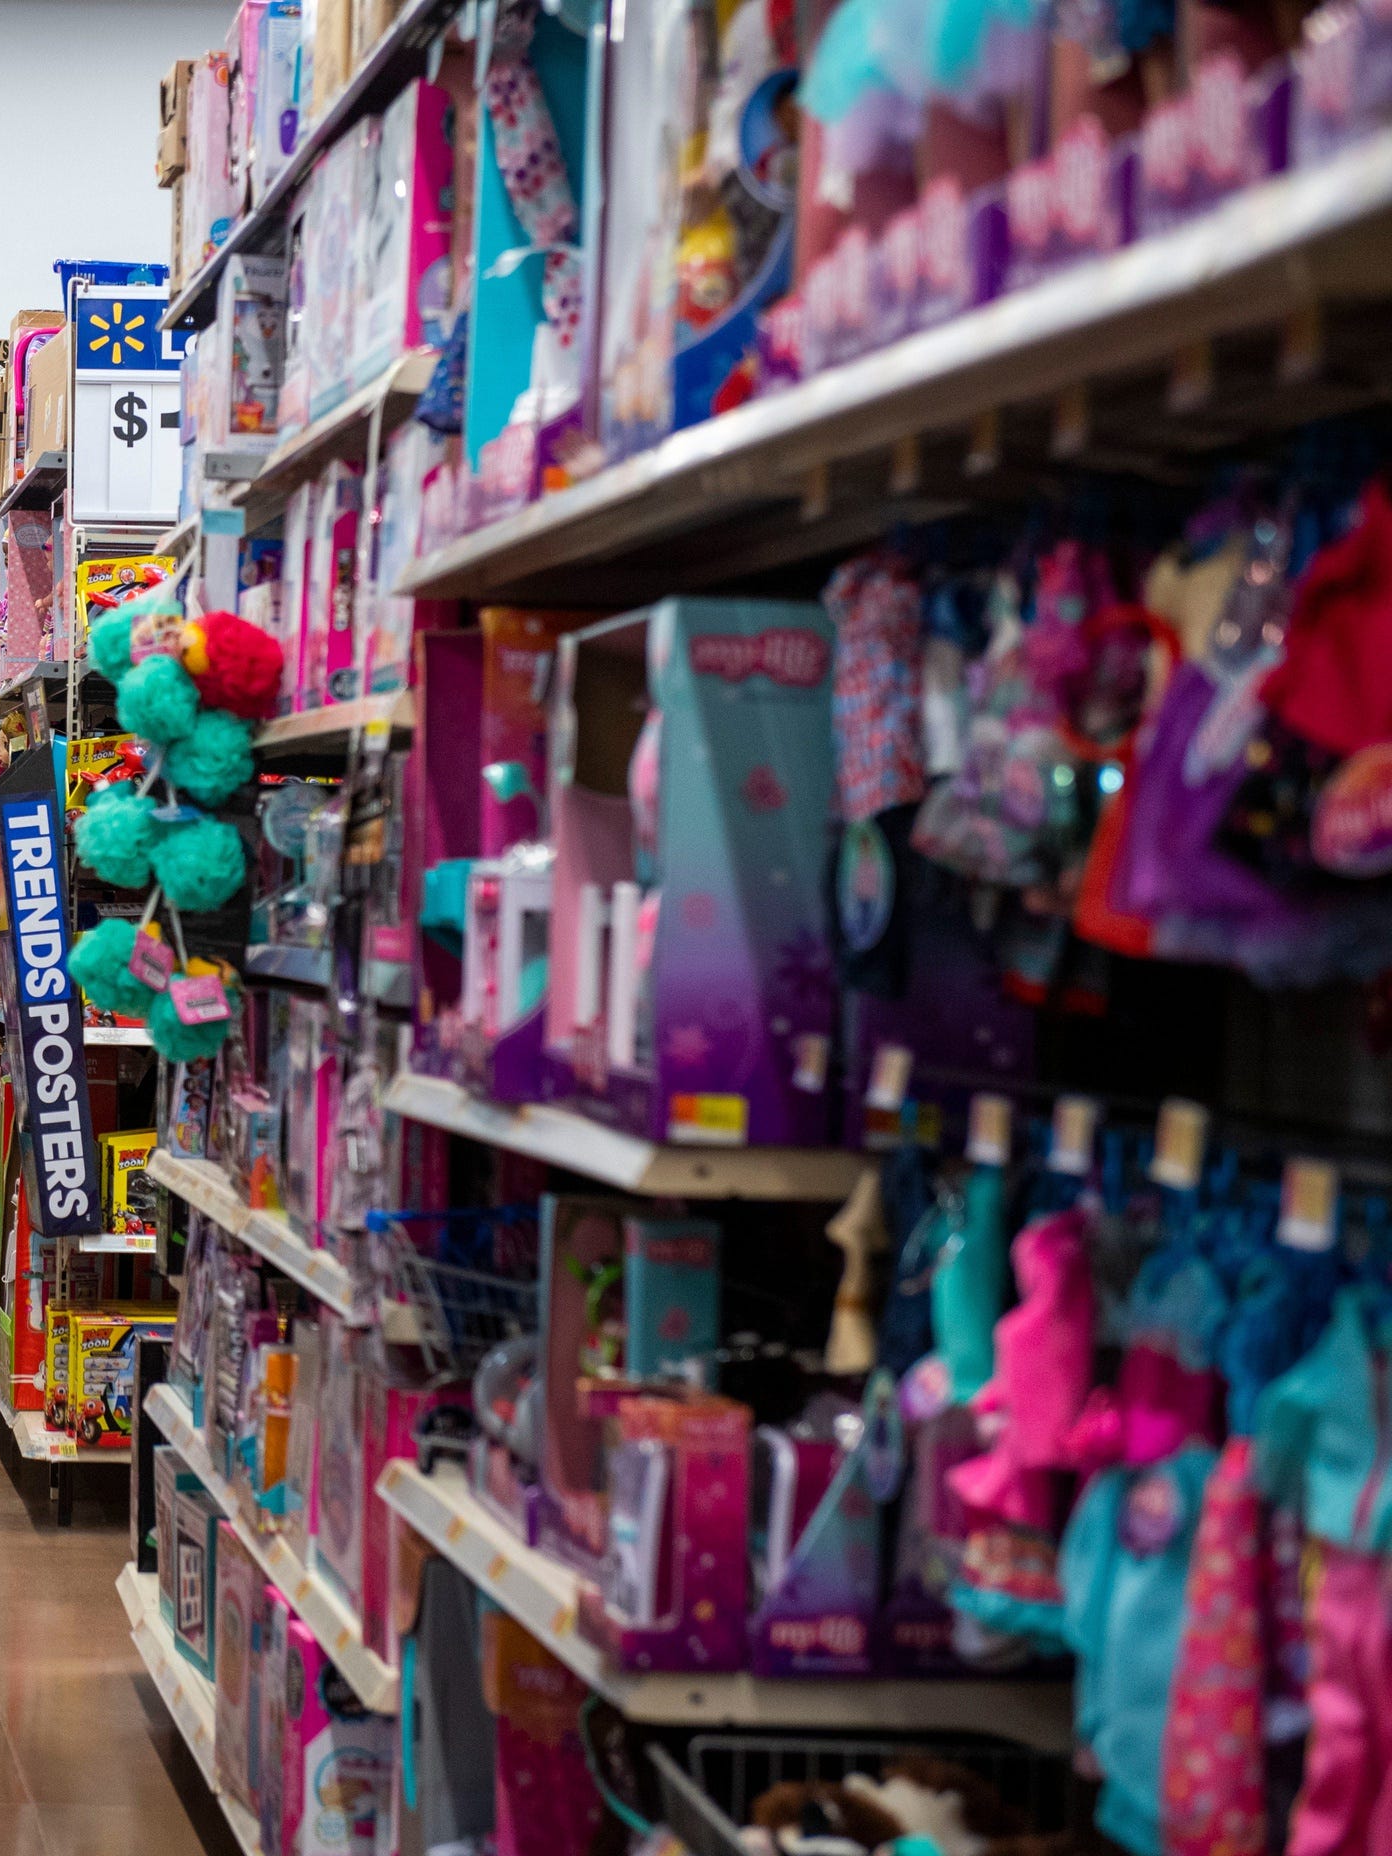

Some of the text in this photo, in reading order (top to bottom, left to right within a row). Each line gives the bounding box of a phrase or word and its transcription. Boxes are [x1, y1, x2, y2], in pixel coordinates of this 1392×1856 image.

[88, 574, 113, 585] ZOOM
[93, 751, 115, 762] ZOOM
[8, 804, 88, 1219] TRENDS POSTERS
[118, 1159, 145, 1170] ZOOM
[82, 1339, 110, 1350] ZOOM
